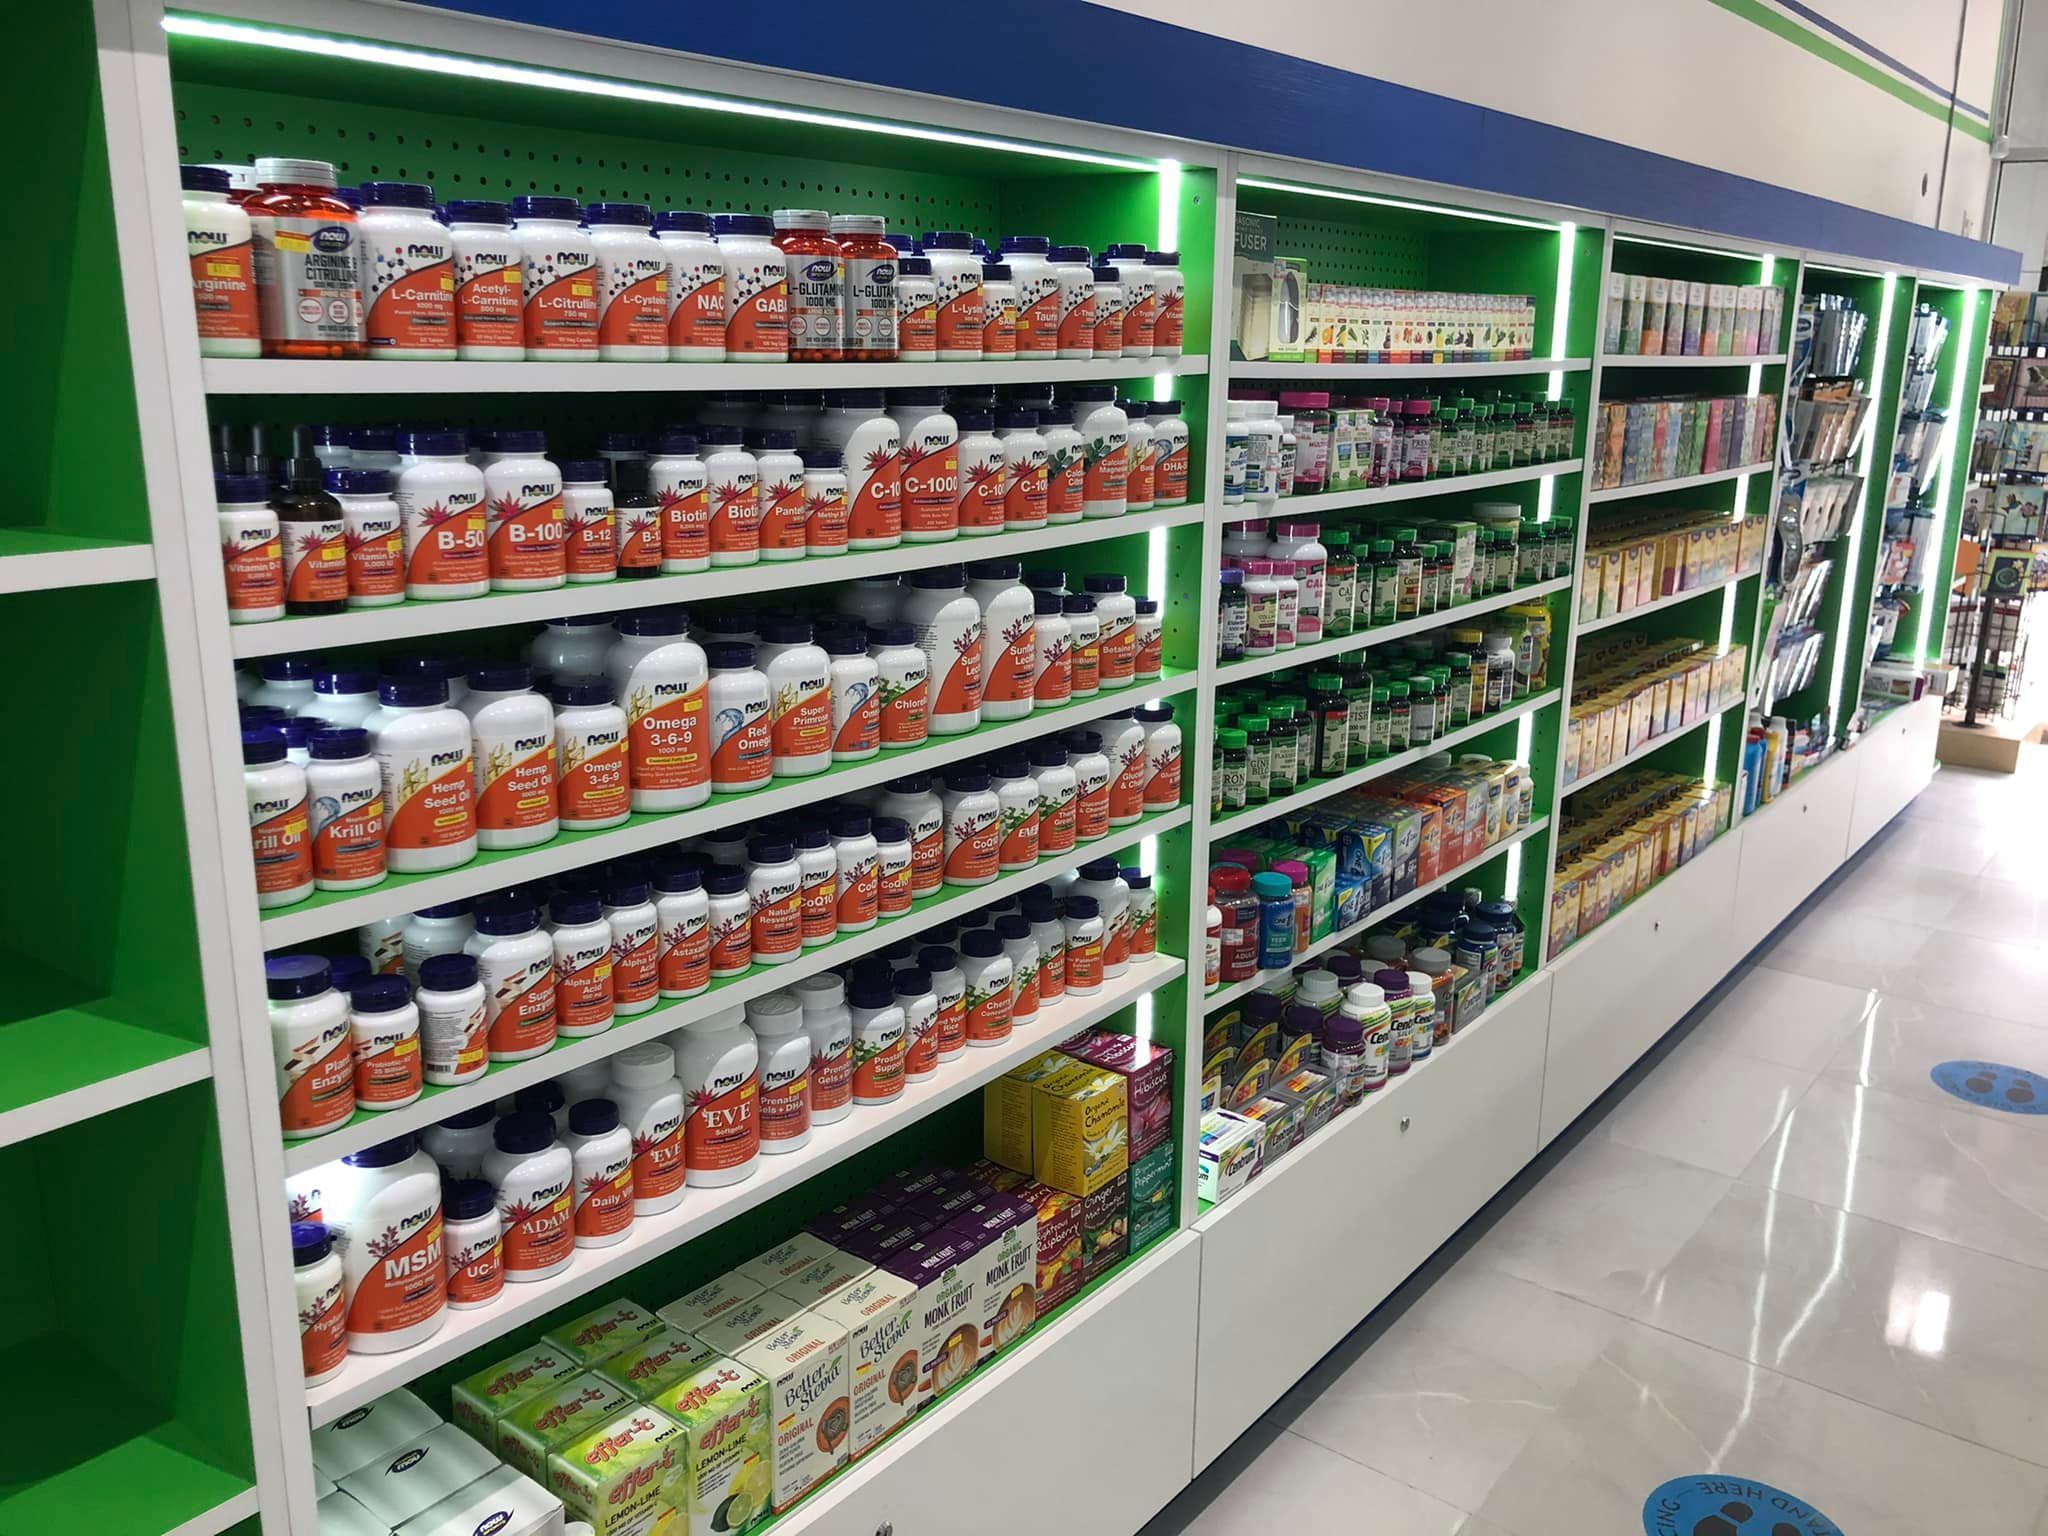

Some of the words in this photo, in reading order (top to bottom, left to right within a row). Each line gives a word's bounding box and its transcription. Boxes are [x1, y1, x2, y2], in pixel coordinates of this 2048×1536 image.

[473, 283, 511, 294] Acetyl-
[462, 295, 518, 307] L-Carnitine
[805, 297, 824, 308] 1000
[870, 298, 887, 308] 1000
[905, 477, 958, 493] C-1000
[671, 510, 707, 523] Biotin
[509, 522, 563, 542] B-100
[583, 529, 611, 542] B-12
[793, 713, 829, 726] Primrose
[800, 706, 825, 716] Super
[643, 715, 697, 731] Omega
[748, 725, 767, 739] Red
[650, 731, 692, 746] 3-6-9
[515, 764, 547, 778] Hemp
[584, 761, 623, 774] Omega
[432, 779, 465, 794] Hemp
[508, 778, 539, 792] Seed
[541, 774, 552, 785] Oil
[589, 773, 620, 785] 3-6-9
[423, 796, 456, 809] Seed
[458, 791, 471, 802] Oil
[330, 823, 364, 839] Krill
[622, 958, 647, 968] Alpha
[564, 978, 591, 987] Alpha
[818, 1075, 837, 1084] Gels
[761, 1094, 800, 1105] Prenatal
[786, 1100, 804, 1112] DHA
[704, 1102, 751, 1128] EVE
[1085, 1098, 1125, 1128] Chamomile
[715, 1125, 743, 1136] Softgels
[1229, 1150, 1255, 1176] Centrum
[592, 1194, 620, 1208] Daily
[522, 1209, 570, 1235] ADAM
[983, 1217, 1000, 1229] MONK
[1000, 1208, 1016, 1221] FRUIT
[385, 1243, 441, 1281] MSM
[921, 1254, 940, 1269] MONK
[940, 1246, 955, 1261] FRUIT
[986, 1264, 1010, 1287] MONK
[1011, 1244, 1033, 1275] FRUIT
[860, 1294, 897, 1316] ORIGINAL
[925, 1304, 950, 1329] MONK
[951, 1283, 974, 1315] FRUIT
[860, 1316, 899, 1360] Better
[873, 1321, 912, 1363] Stevia
[785, 1338, 826, 1363] ORIGINAL
[485, 1356, 557, 1398] effer-c
[785, 1363, 826, 1408] Better
[853, 1369, 887, 1396] ORIGINAL
[675, 1367, 742, 1413] effer-c
[800, 1368, 842, 1411] Stevia
[534, 1387, 605, 1432] effer-c
[700, 1395, 761, 1451] effer-c
[584, 1417, 657, 1466] effer-c
[777, 1420, 814, 1447] ORIGINAL
[695, 1434, 748, 1472] LEMON-LIME
[609, 1445, 675, 1504] effer-c
[1696, 1481, 1765, 1500] HERE
[605, 1485, 660, 1528] LEMON-LIME
